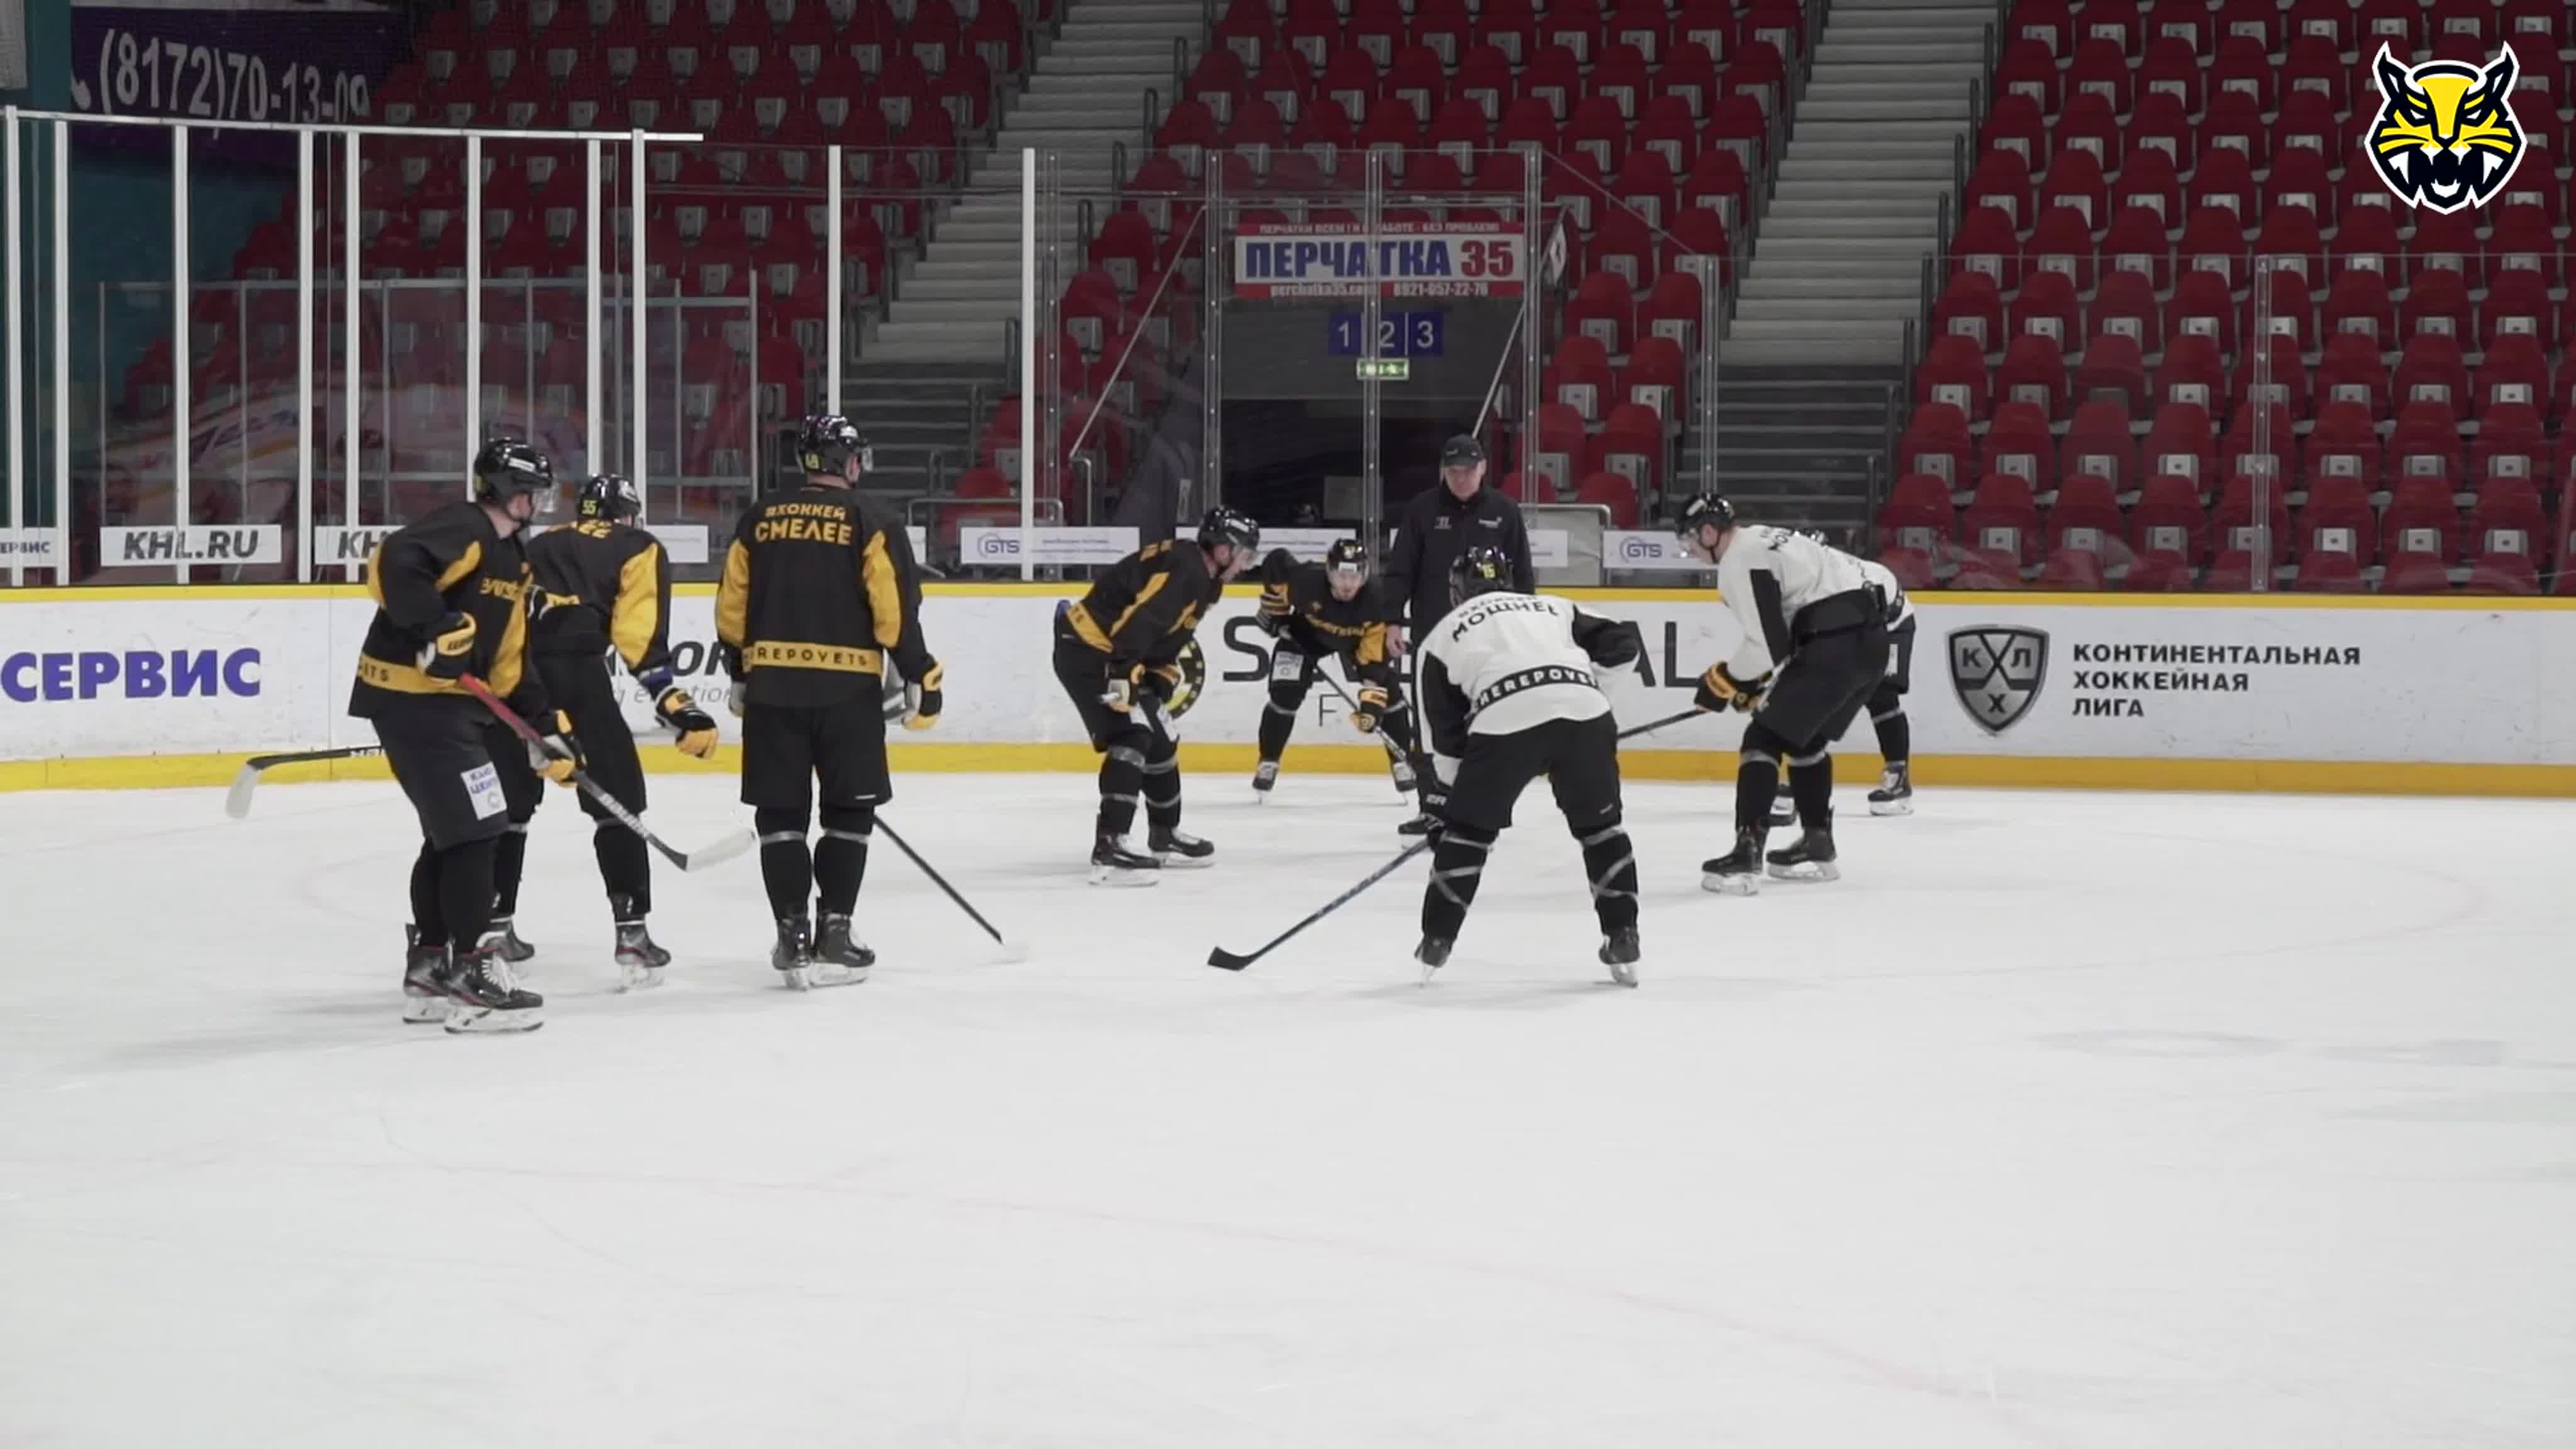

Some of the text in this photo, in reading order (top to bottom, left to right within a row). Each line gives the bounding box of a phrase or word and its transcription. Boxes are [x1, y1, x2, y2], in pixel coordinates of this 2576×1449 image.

[1246, 240, 1514, 277] ПЕРЧАТКА 35
[1338, 321, 1434, 348] 1 2 3
[755, 518, 853, 547] СМЕЛЕЕ
[123, 531, 258, 560] KHL.RU
[985, 539, 1020, 554] GTS
[1626, 542, 1662, 558] GTS
[2074, 644, 2361, 665] КОНТИНЕНТАЛЬНАЯ
[1, 648, 261, 702] СЕРВИС
[2074, 669, 2248, 691] ХОККЕЙНАЯ
[2072, 699, 2144, 717] ЛИГА
